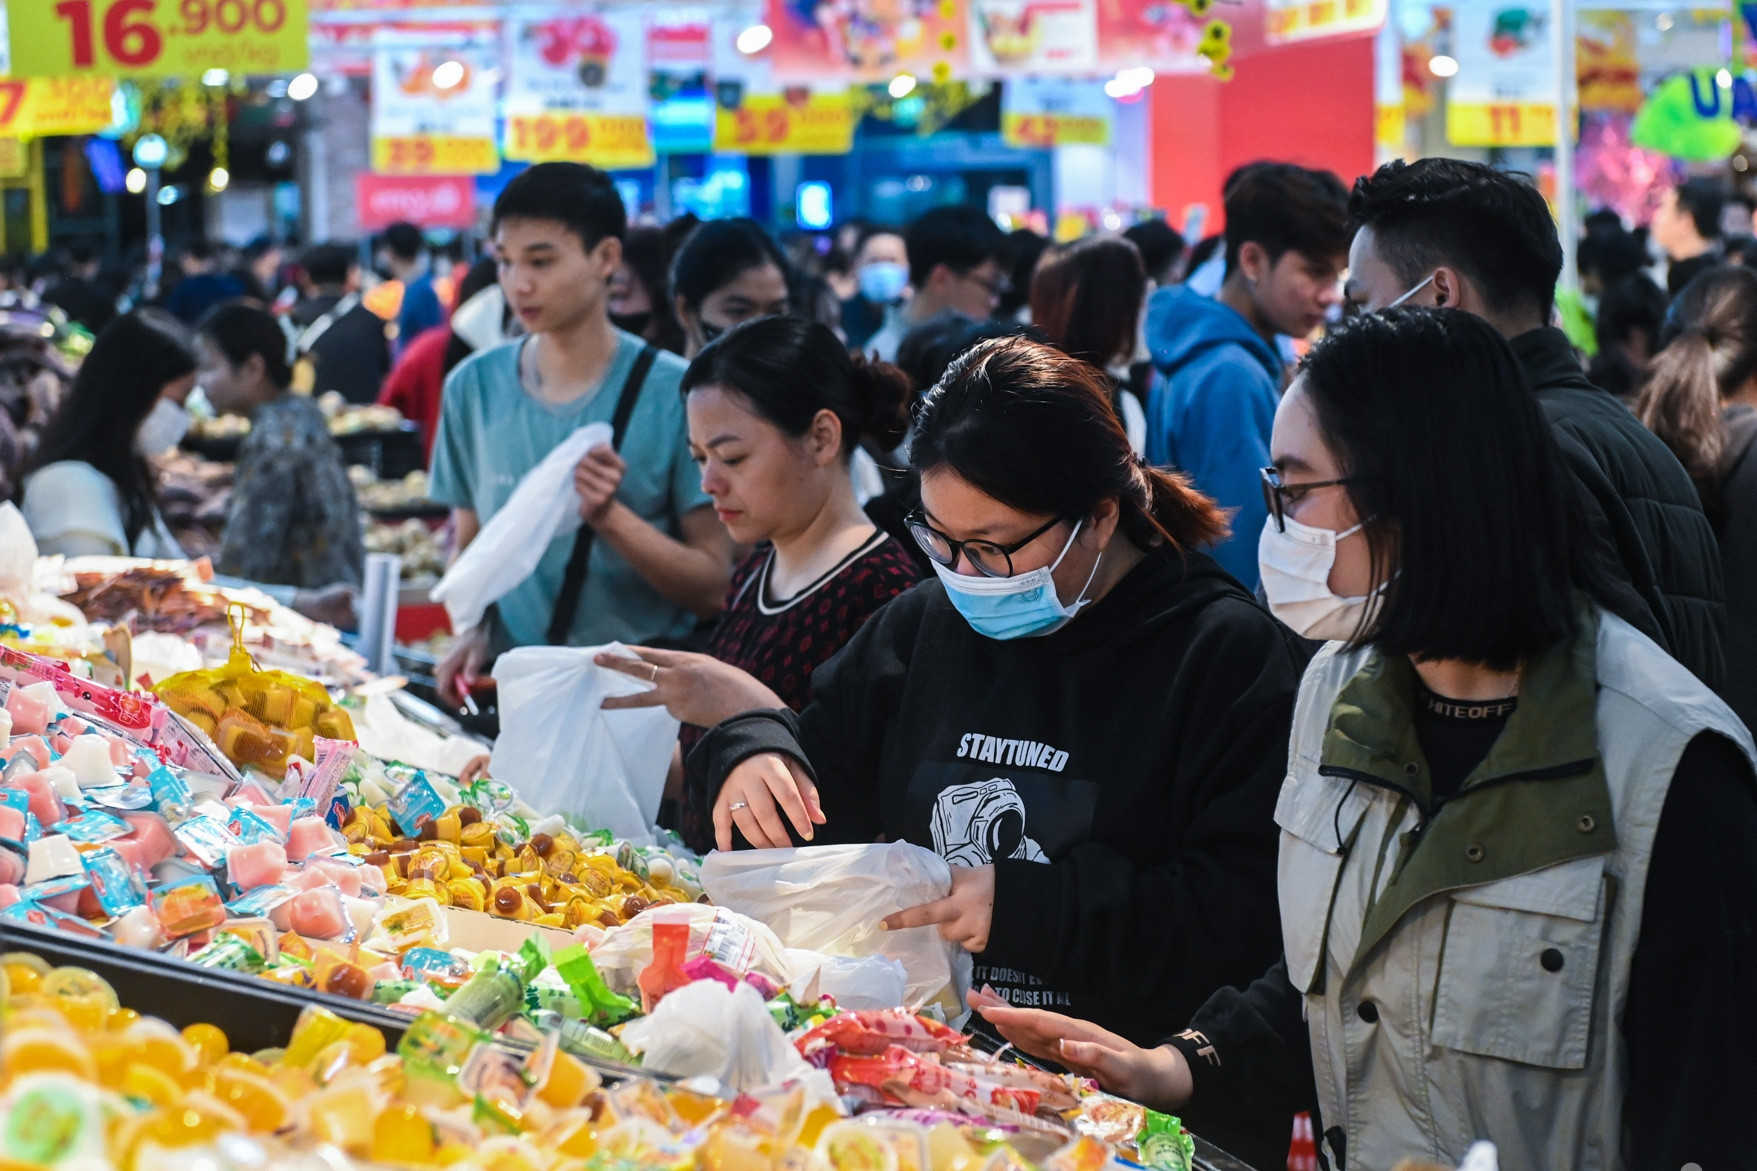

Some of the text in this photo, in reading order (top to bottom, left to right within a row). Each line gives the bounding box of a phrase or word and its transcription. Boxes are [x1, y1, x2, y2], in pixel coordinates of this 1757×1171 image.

[956, 732, 1070, 772] STAYTUNED
[976, 965, 989, 980] IT
[1042, 990, 1054, 1006] IT
